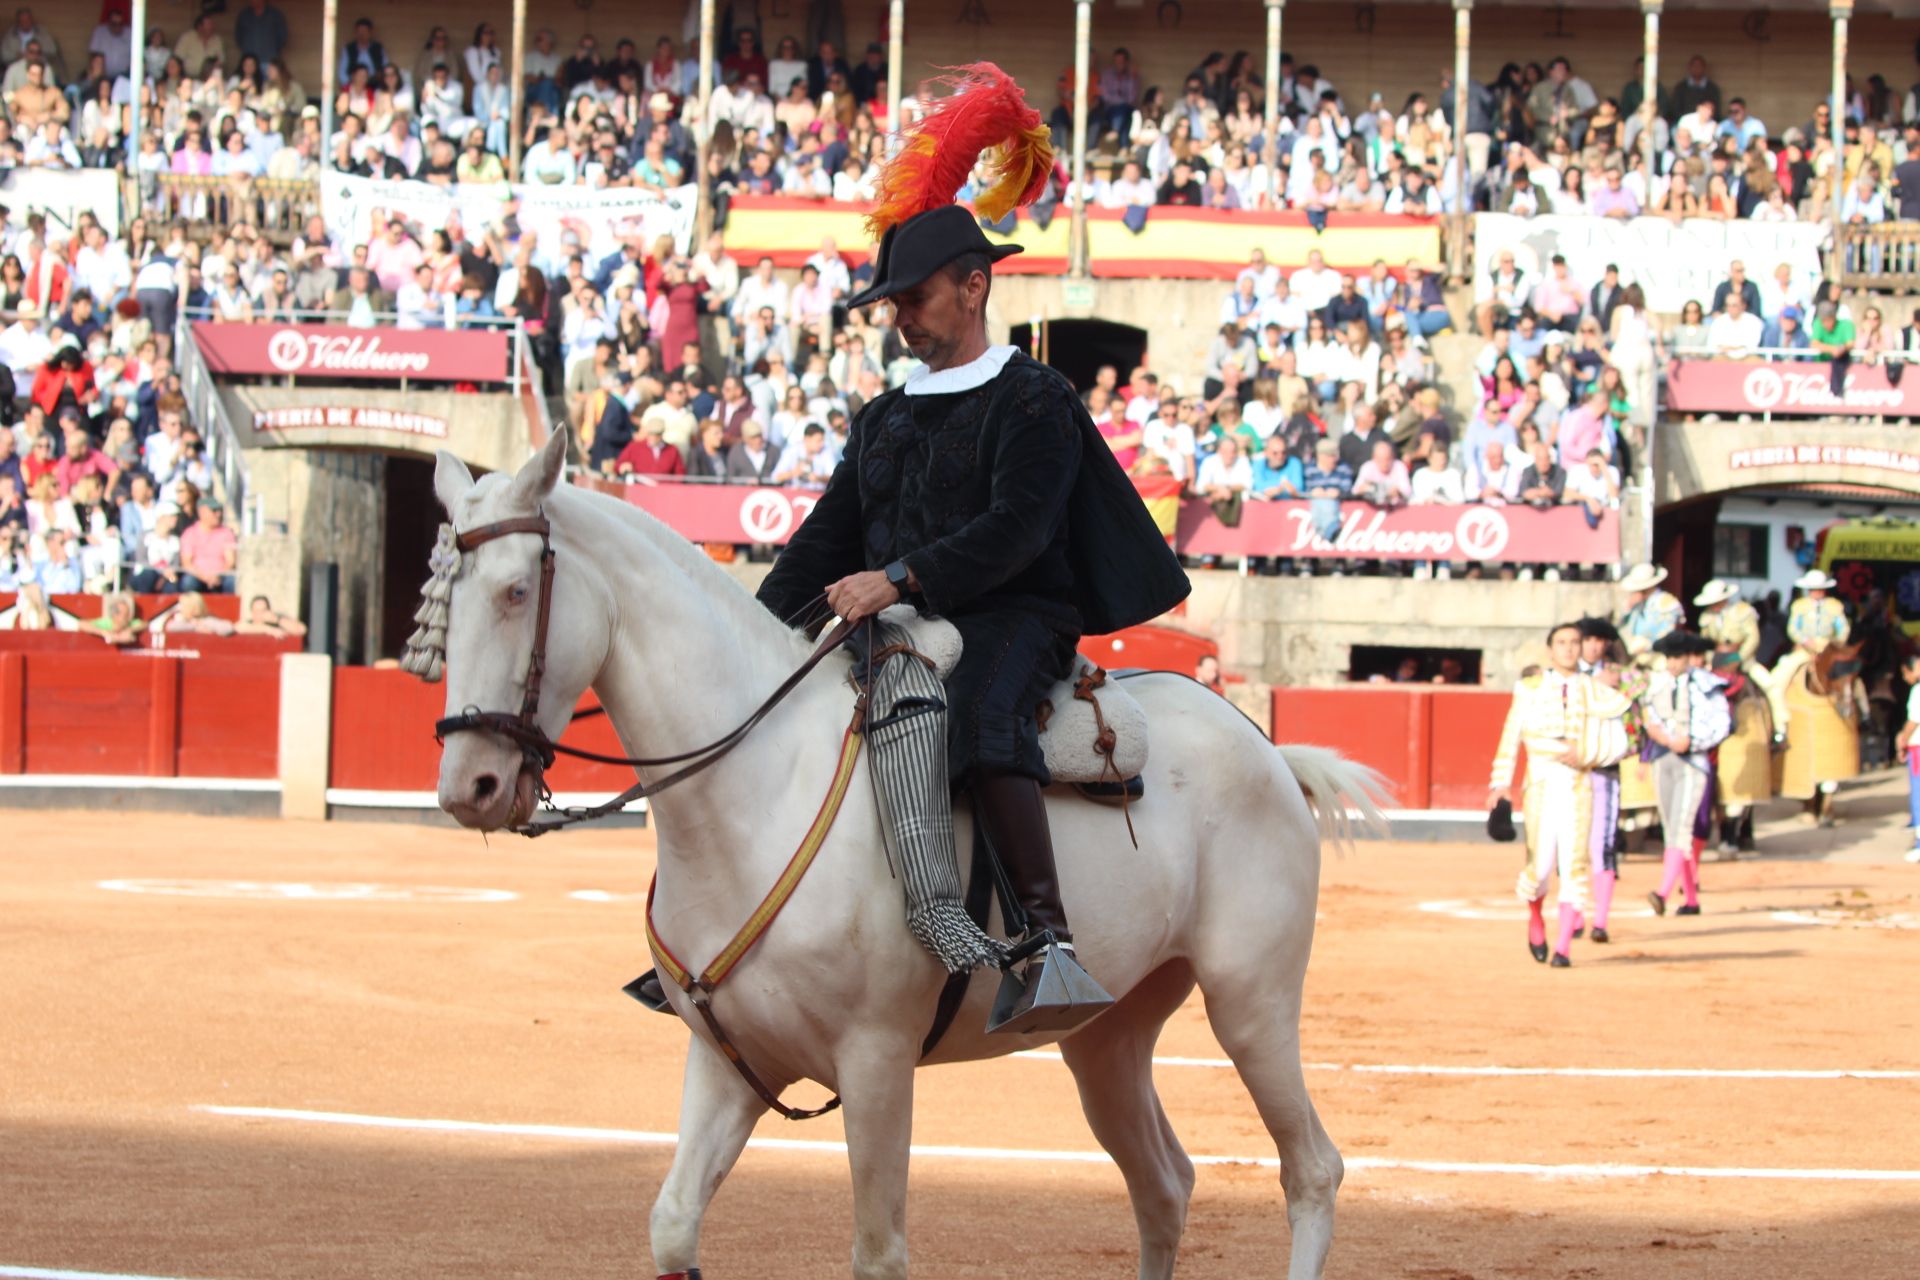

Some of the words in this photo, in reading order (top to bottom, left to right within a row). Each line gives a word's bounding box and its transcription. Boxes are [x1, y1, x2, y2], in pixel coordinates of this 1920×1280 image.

[307, 335, 430, 371] Valduero
[255, 408, 324, 429] PUERTA
[327, 408, 351, 427] DE
[354, 408, 447, 437] ARRASTRE
[1797, 446, 1820, 464] DE
